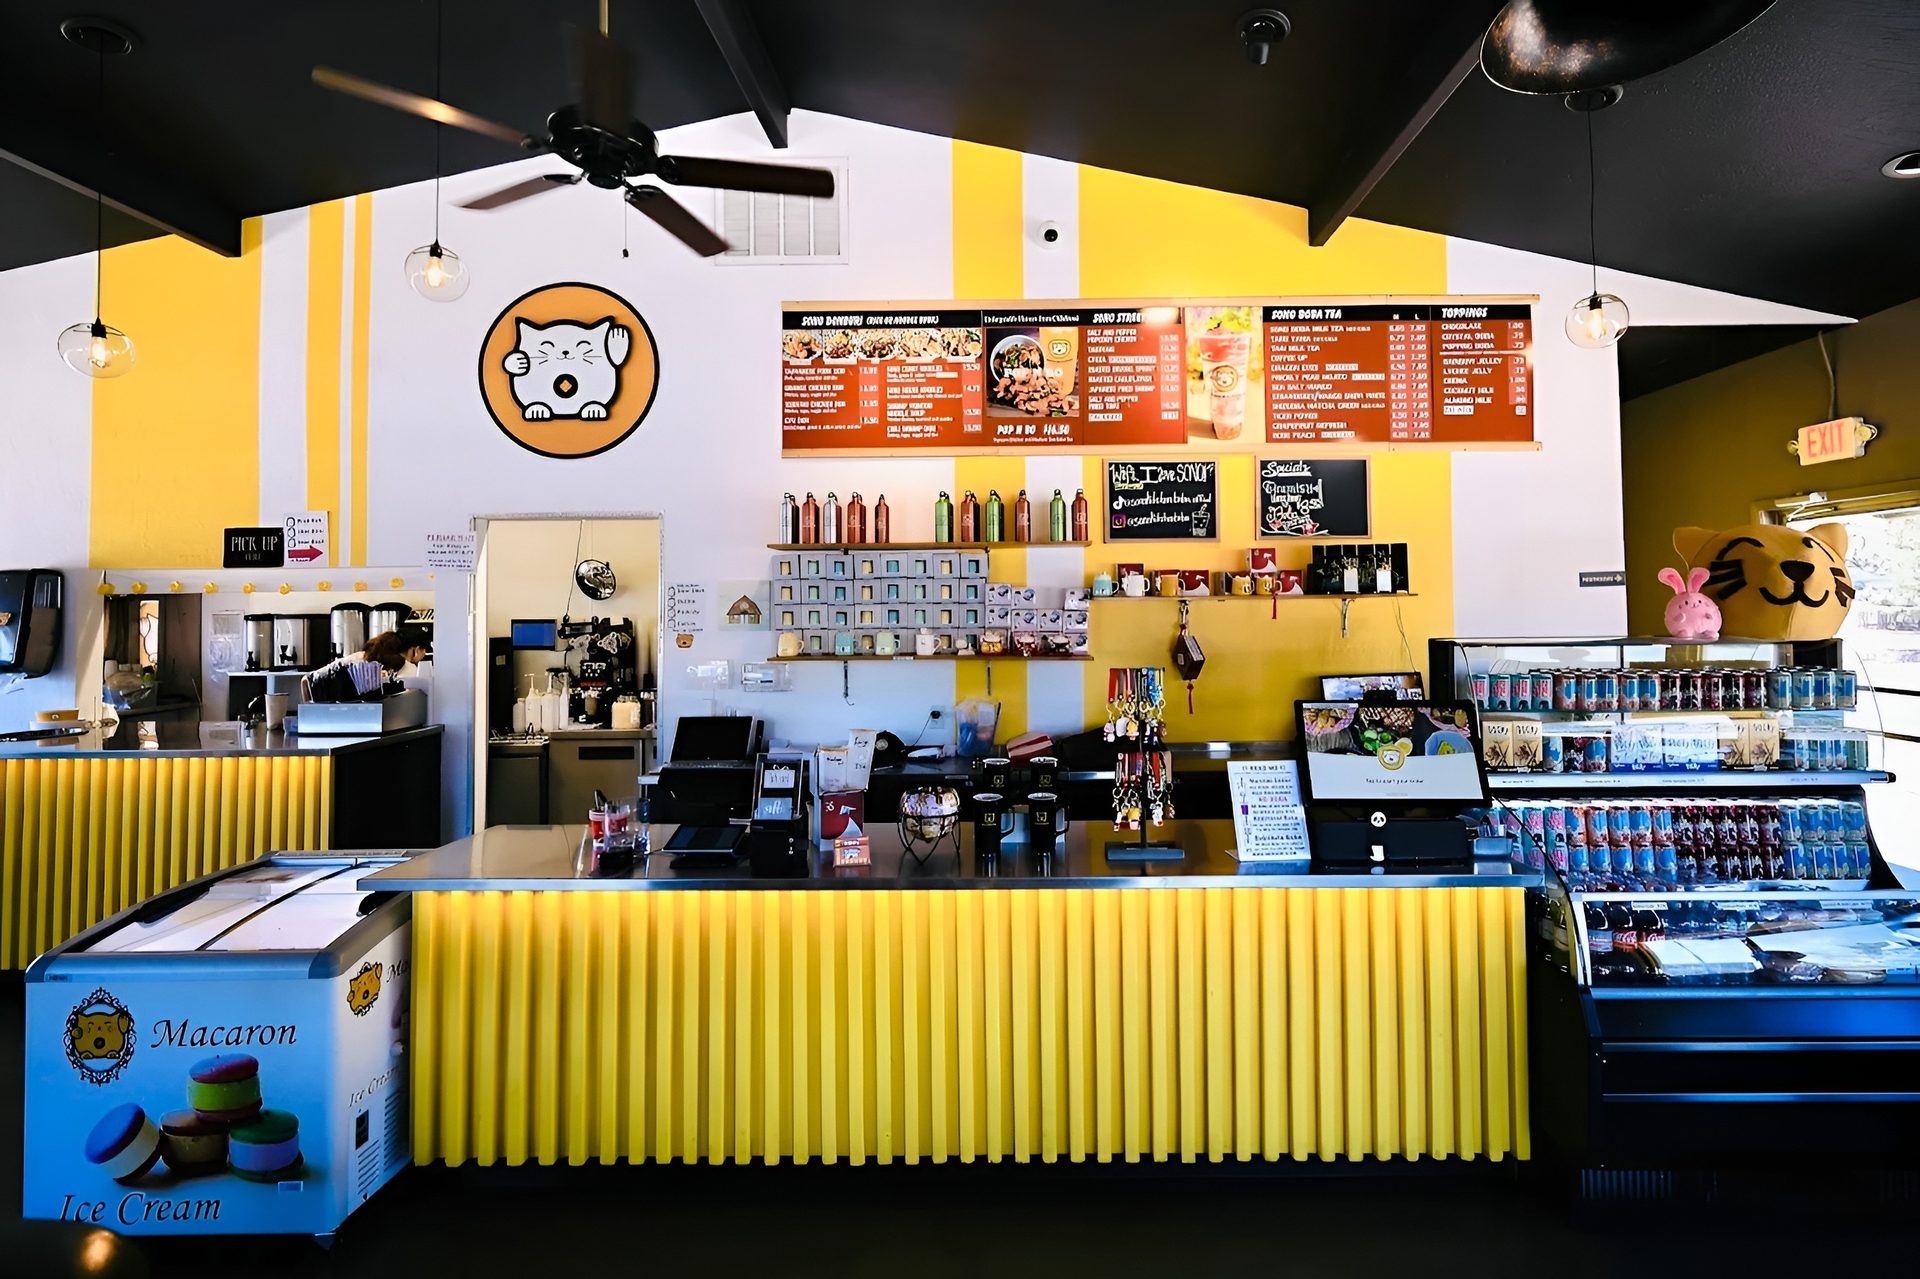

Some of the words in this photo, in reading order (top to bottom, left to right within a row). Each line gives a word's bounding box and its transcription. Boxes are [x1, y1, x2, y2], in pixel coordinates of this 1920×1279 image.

[1441, 307, 1488, 319] TOPPINGS
[1807, 420, 1845, 459] EXIT
[231, 536, 257, 552] PICK
[262, 535, 279, 552] UP
[150, 1019, 298, 1049] Macaron
[60, 1193, 107, 1224] Ice
[118, 1191, 223, 1226] Cream
